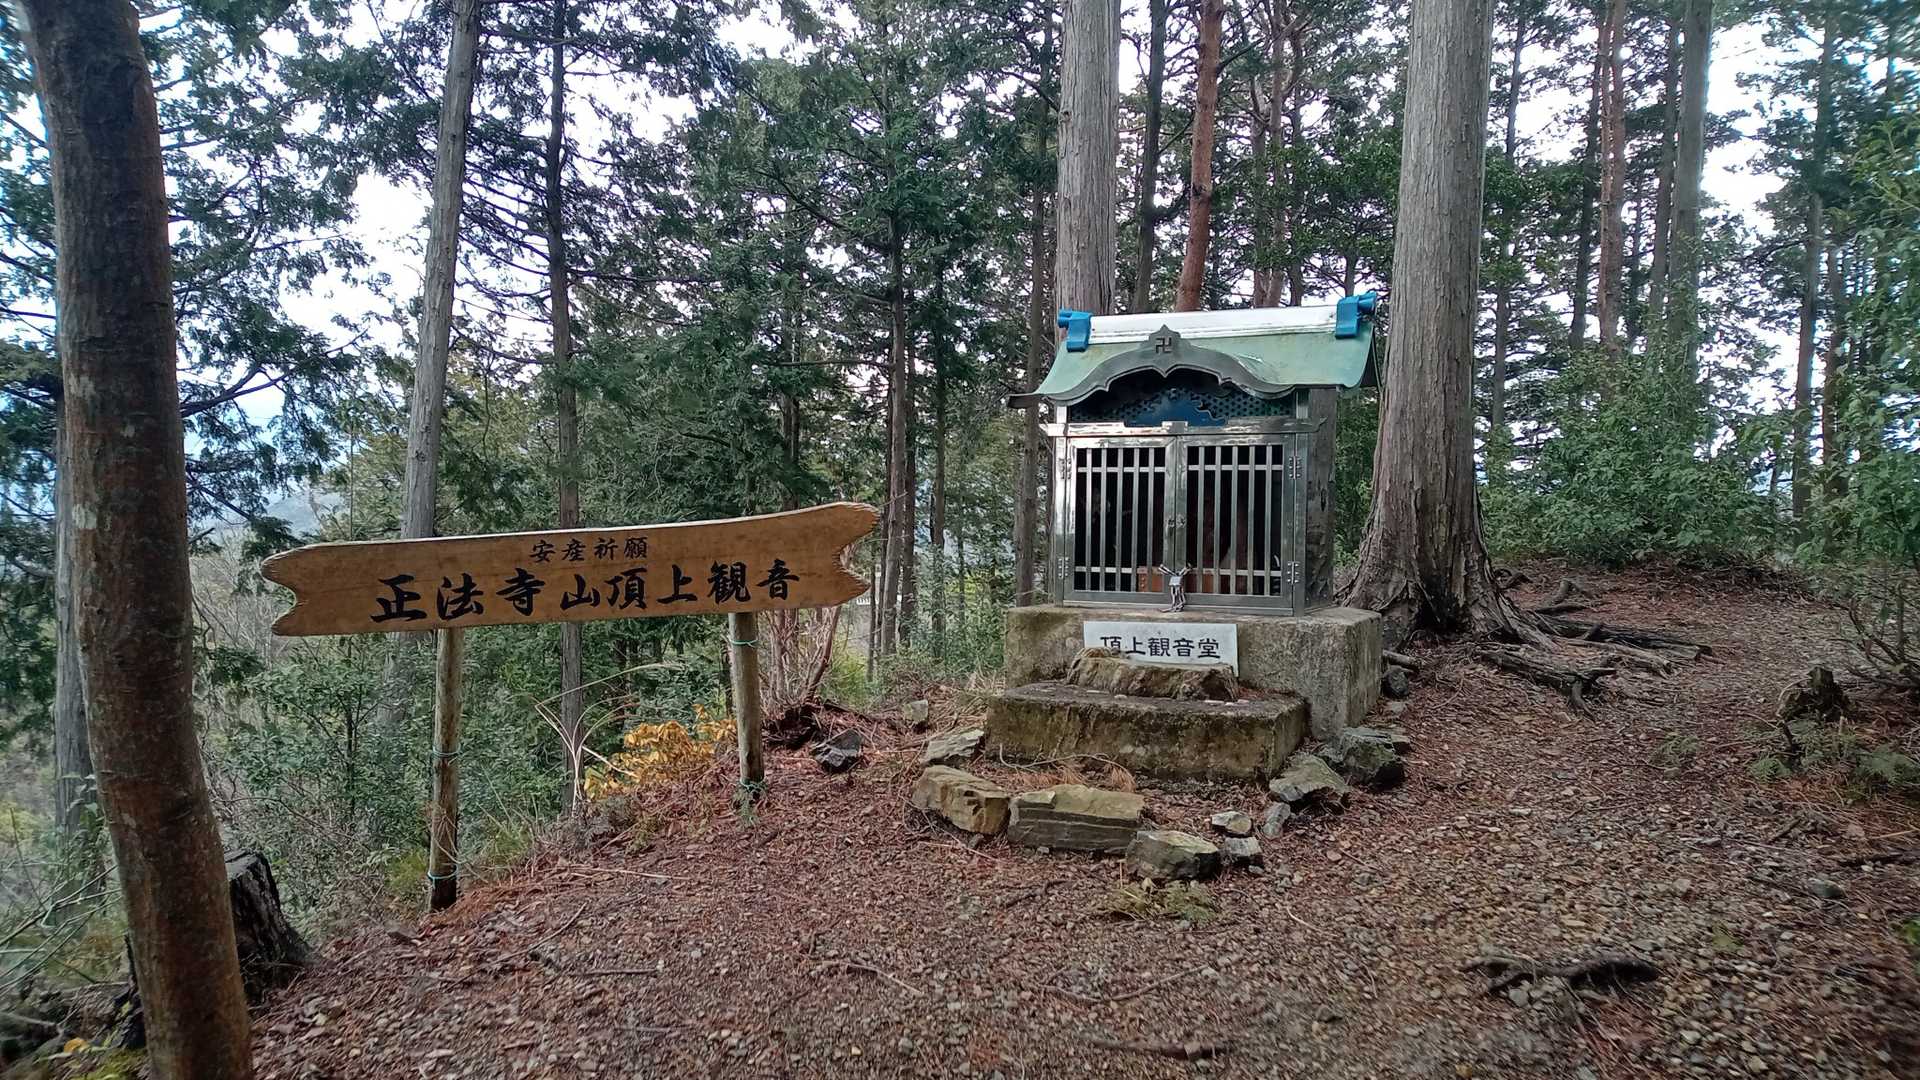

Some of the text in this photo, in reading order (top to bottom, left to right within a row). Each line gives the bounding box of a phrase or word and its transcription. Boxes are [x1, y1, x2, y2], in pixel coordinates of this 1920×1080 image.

[529, 537, 648, 563] 安産祈願
[371, 559, 800, 623] 正法寺山頂上観音
